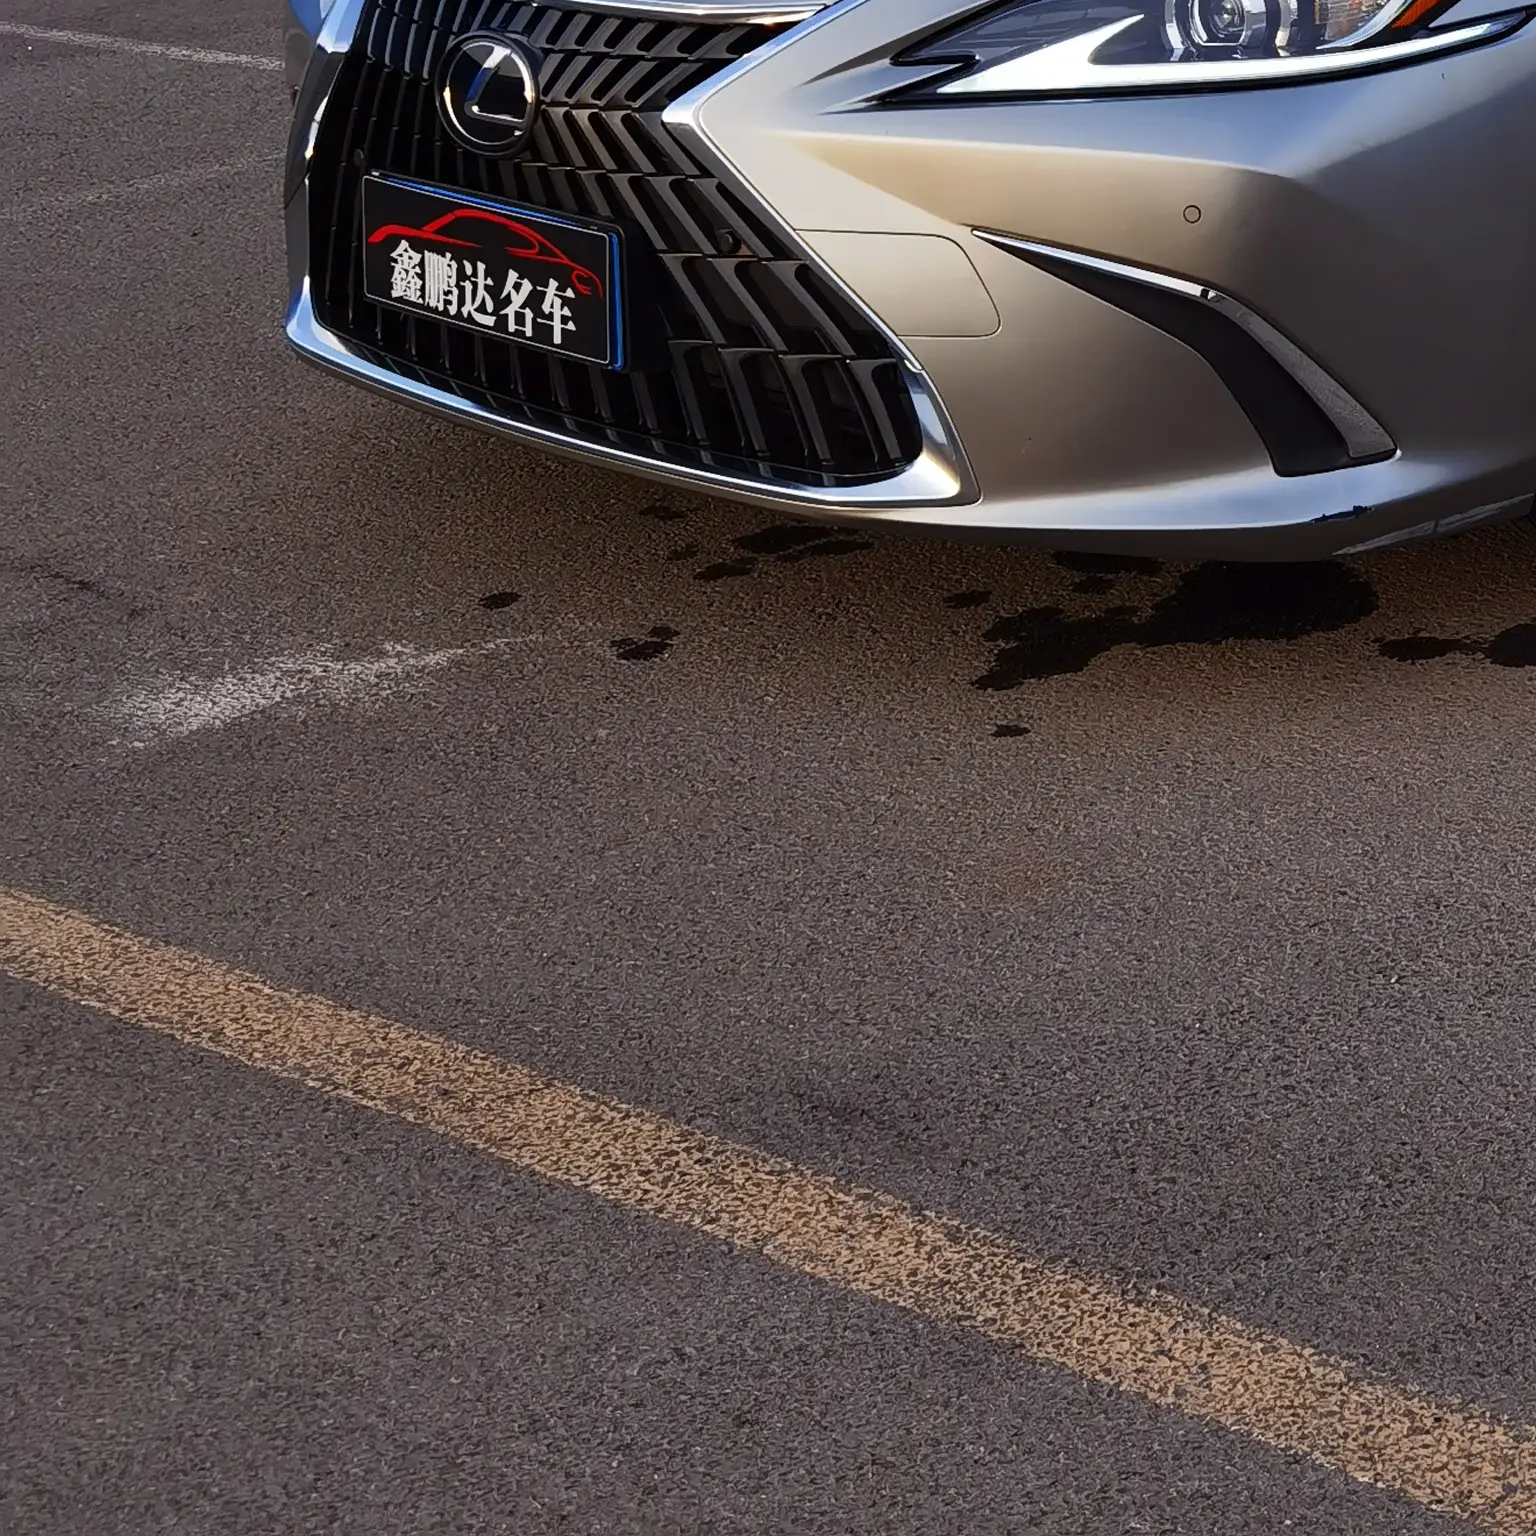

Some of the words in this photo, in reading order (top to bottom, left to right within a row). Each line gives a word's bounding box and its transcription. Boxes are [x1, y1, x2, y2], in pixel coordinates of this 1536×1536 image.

[390, 240, 576, 344] 鑫鹏达名车
